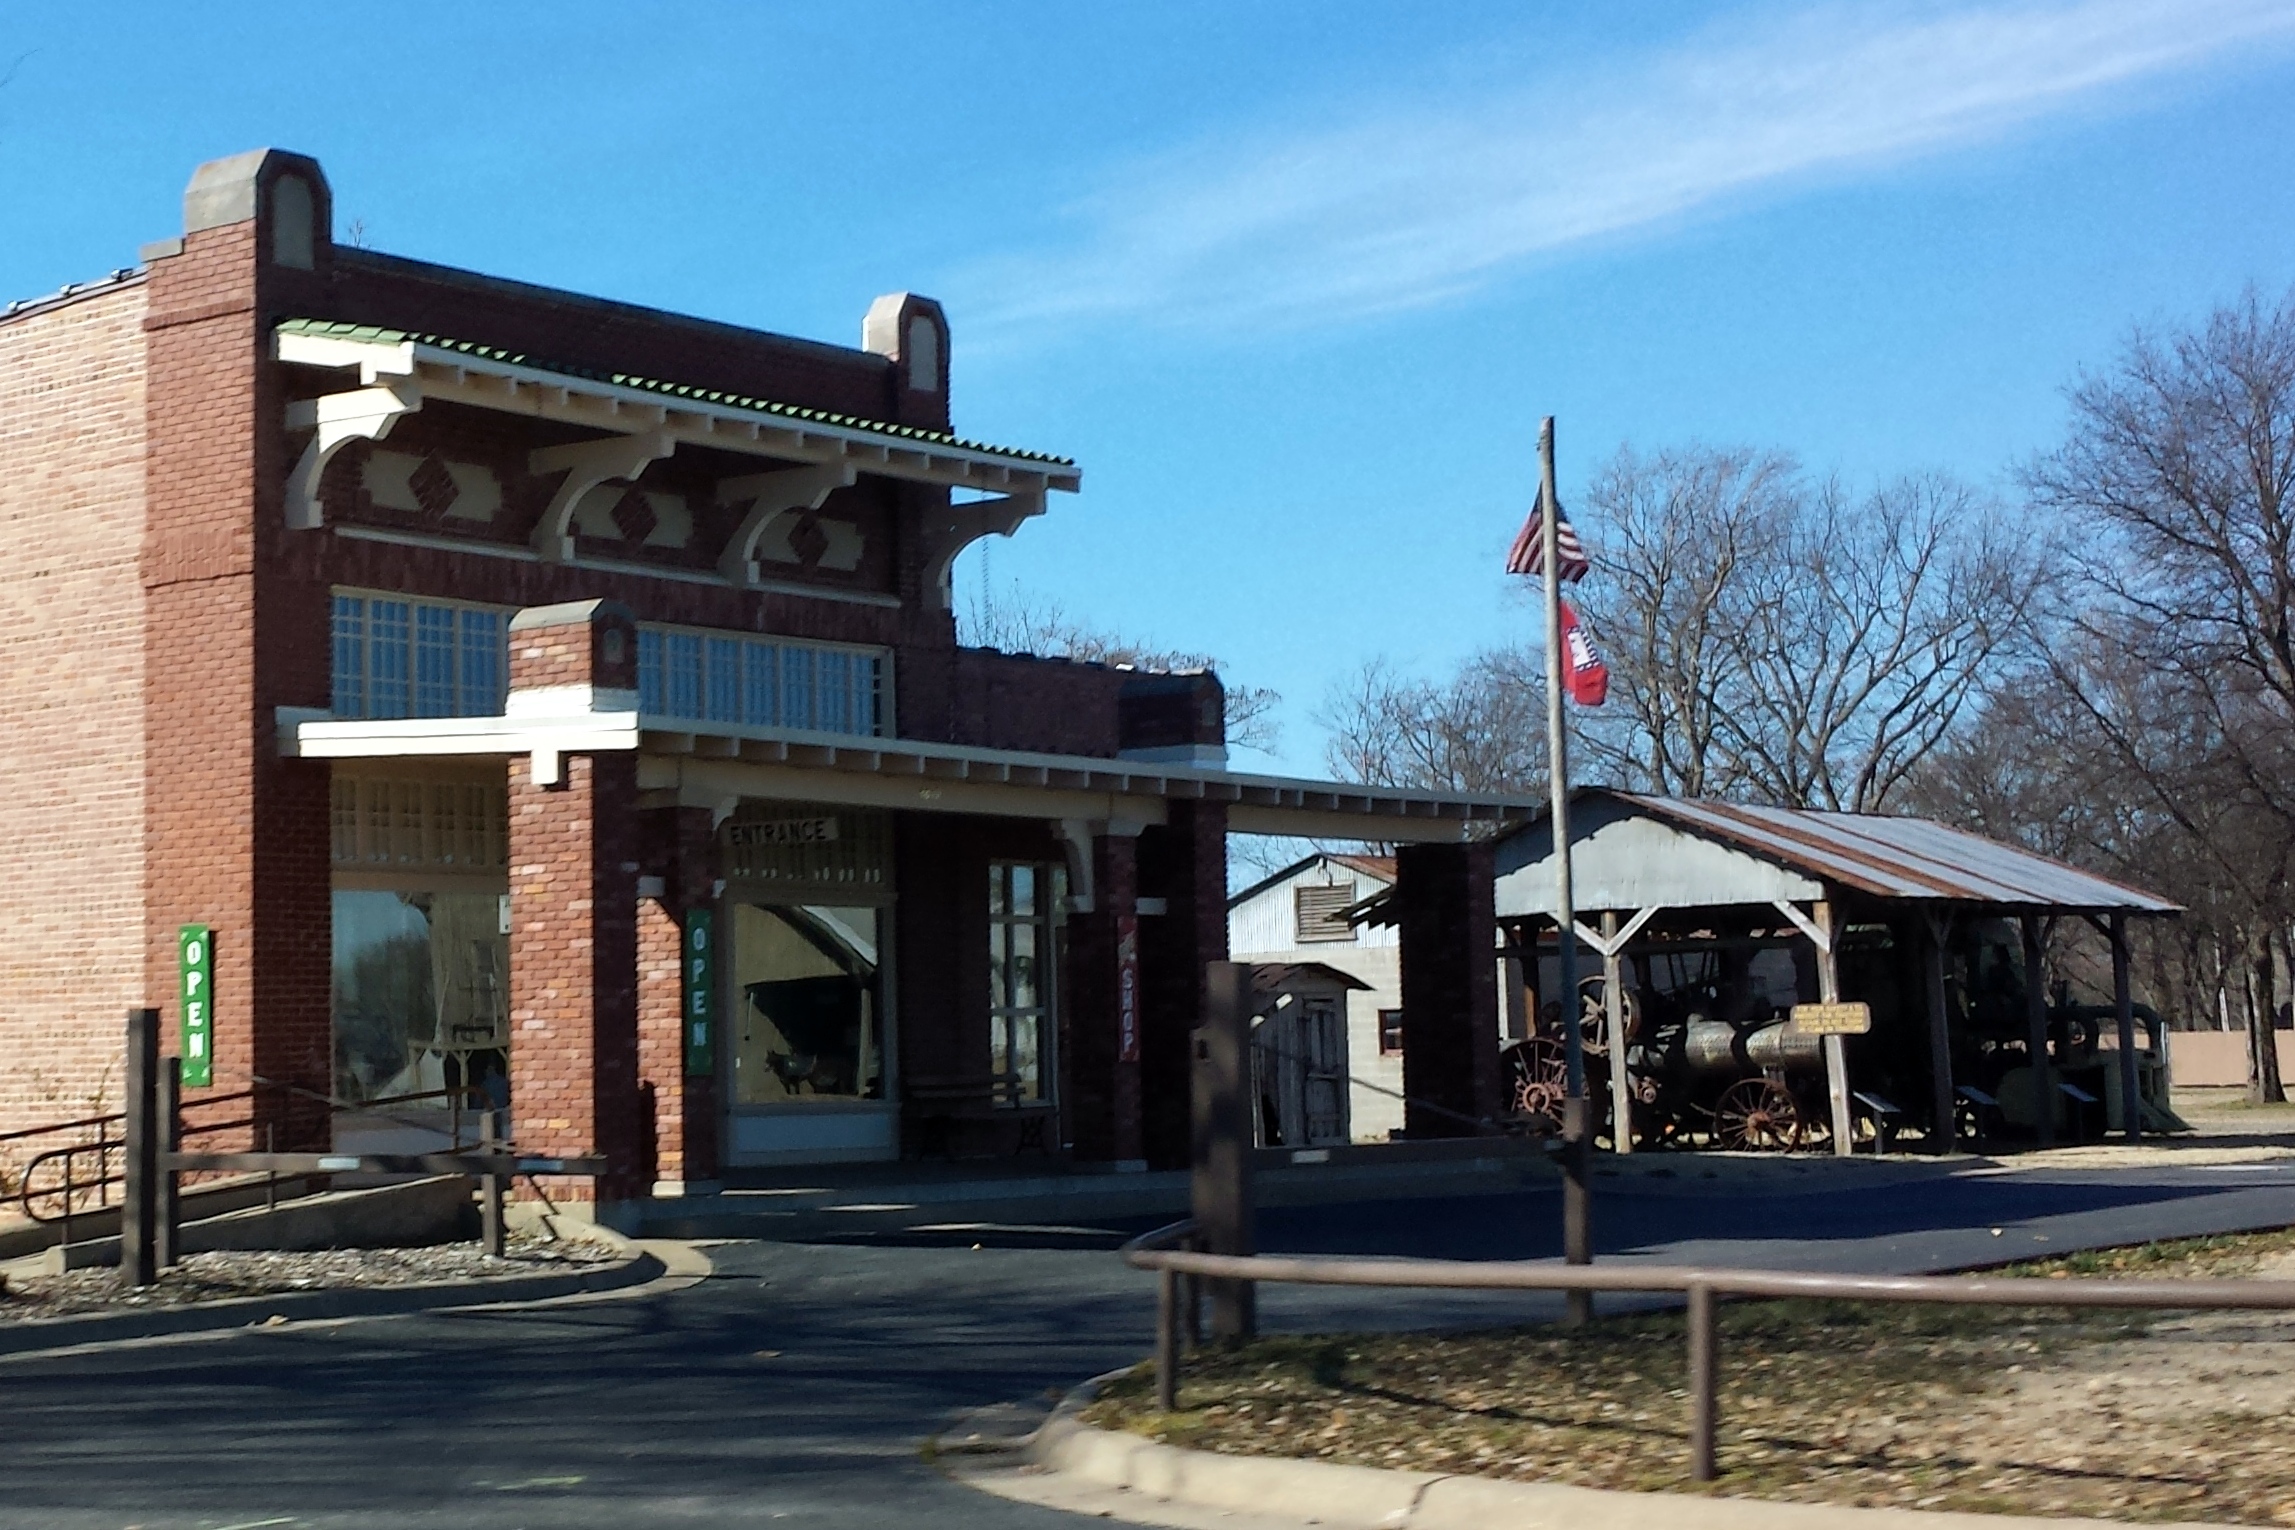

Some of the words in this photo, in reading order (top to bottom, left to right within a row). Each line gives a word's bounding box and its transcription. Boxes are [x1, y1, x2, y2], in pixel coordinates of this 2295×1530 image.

[730, 819, 828, 846] ENTRANCE
[186, 940, 205, 1059] OPEN
[691, 926, 707, 1047] OPEN
